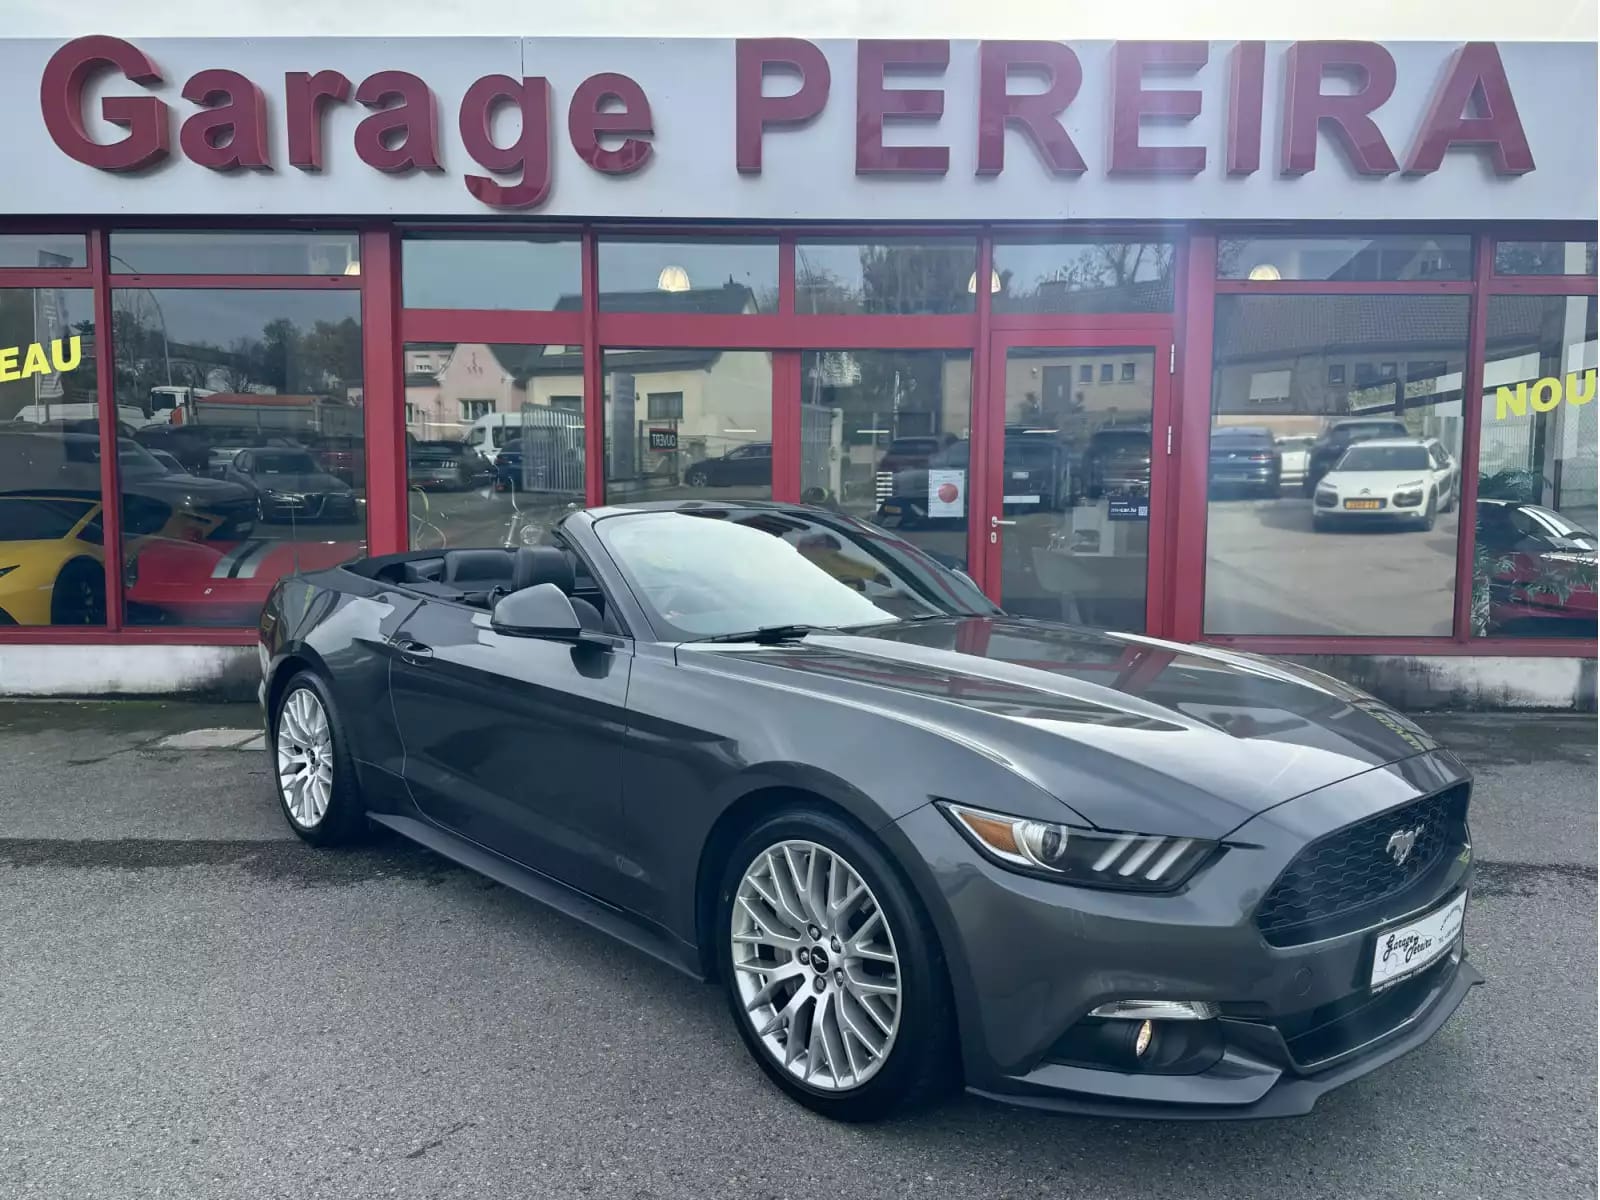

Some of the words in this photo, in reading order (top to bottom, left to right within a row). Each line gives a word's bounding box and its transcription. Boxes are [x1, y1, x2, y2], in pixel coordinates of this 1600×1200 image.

[40, 34, 655, 210] Garage
[735, 38, 1537, 178] PEREIRA
[0, 335, 82, 383] EAU
[1496, 368, 1597, 421] NOU
[1382, 933, 1414, 962] Garage
[1405, 936, 1432, 963] Pereira
